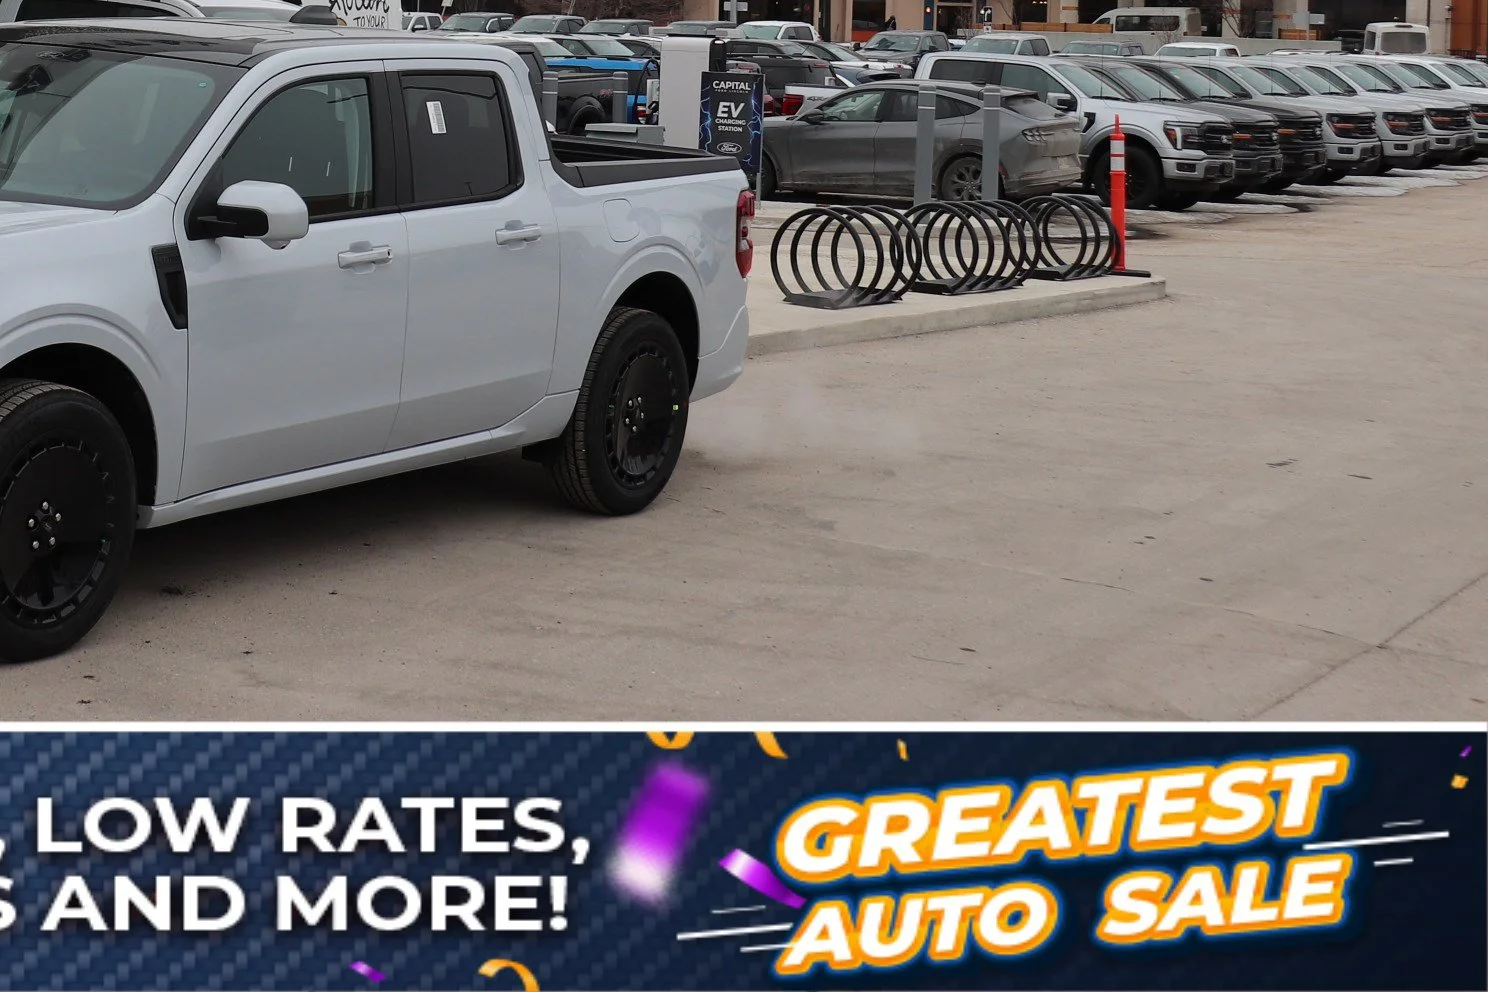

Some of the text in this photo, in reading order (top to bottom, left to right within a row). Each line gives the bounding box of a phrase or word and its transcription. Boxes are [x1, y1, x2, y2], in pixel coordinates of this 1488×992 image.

[353, 15, 386, 28] TO YOUR
[712, 80, 751, 90] CAPITAL
[716, 101, 745, 118] EV
[715, 118, 746, 126] CHARGING
[720, 143, 738, 152] Ford
